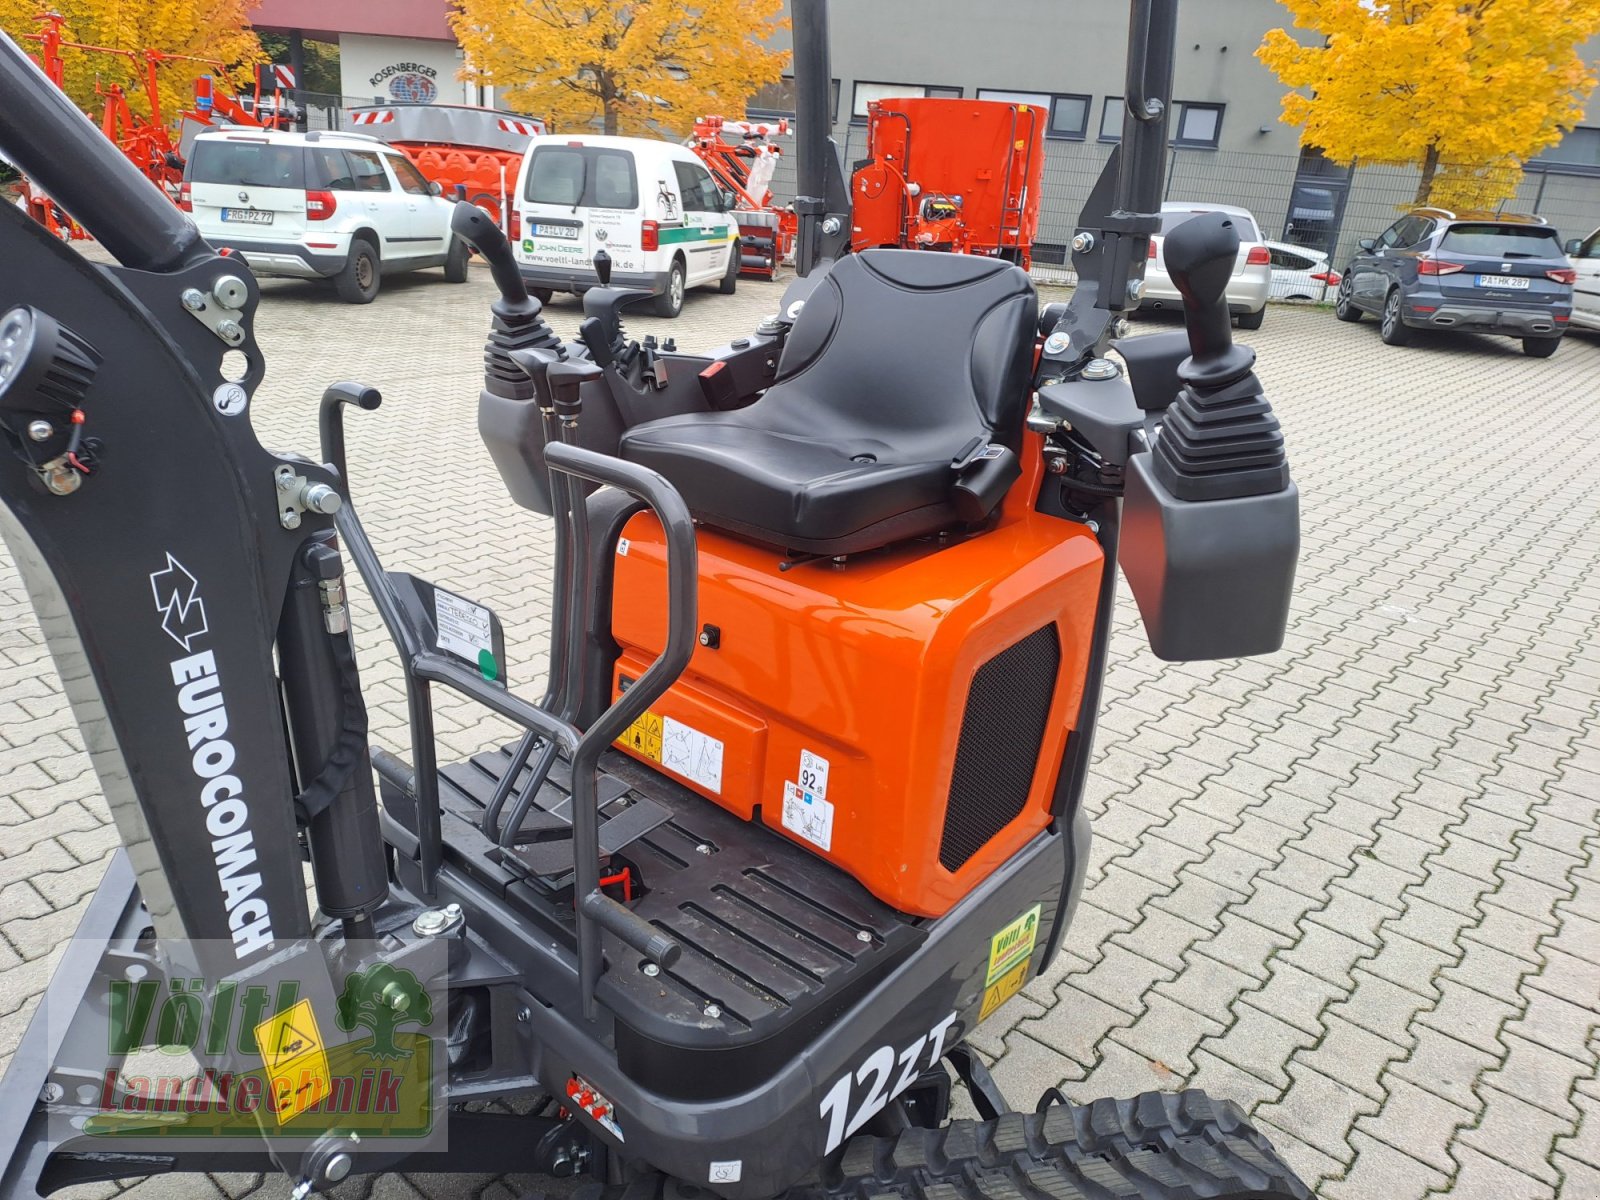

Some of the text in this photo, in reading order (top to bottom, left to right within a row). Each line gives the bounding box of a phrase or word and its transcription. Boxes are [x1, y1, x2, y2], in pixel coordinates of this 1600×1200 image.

[369, 62, 437, 87] ROSENBERGER
[227, 209, 272, 222] FRG PZ 77
[539, 225, 575, 237] PA LV 20
[537, 244, 584, 254] JOHN DEERE
[1481, 276, 1529, 287] PA HK 287
[801, 769, 816, 790] 92
[169, 649, 275, 960] EUROCOMACH
[820, 1011, 957, 1157] 12ZT
